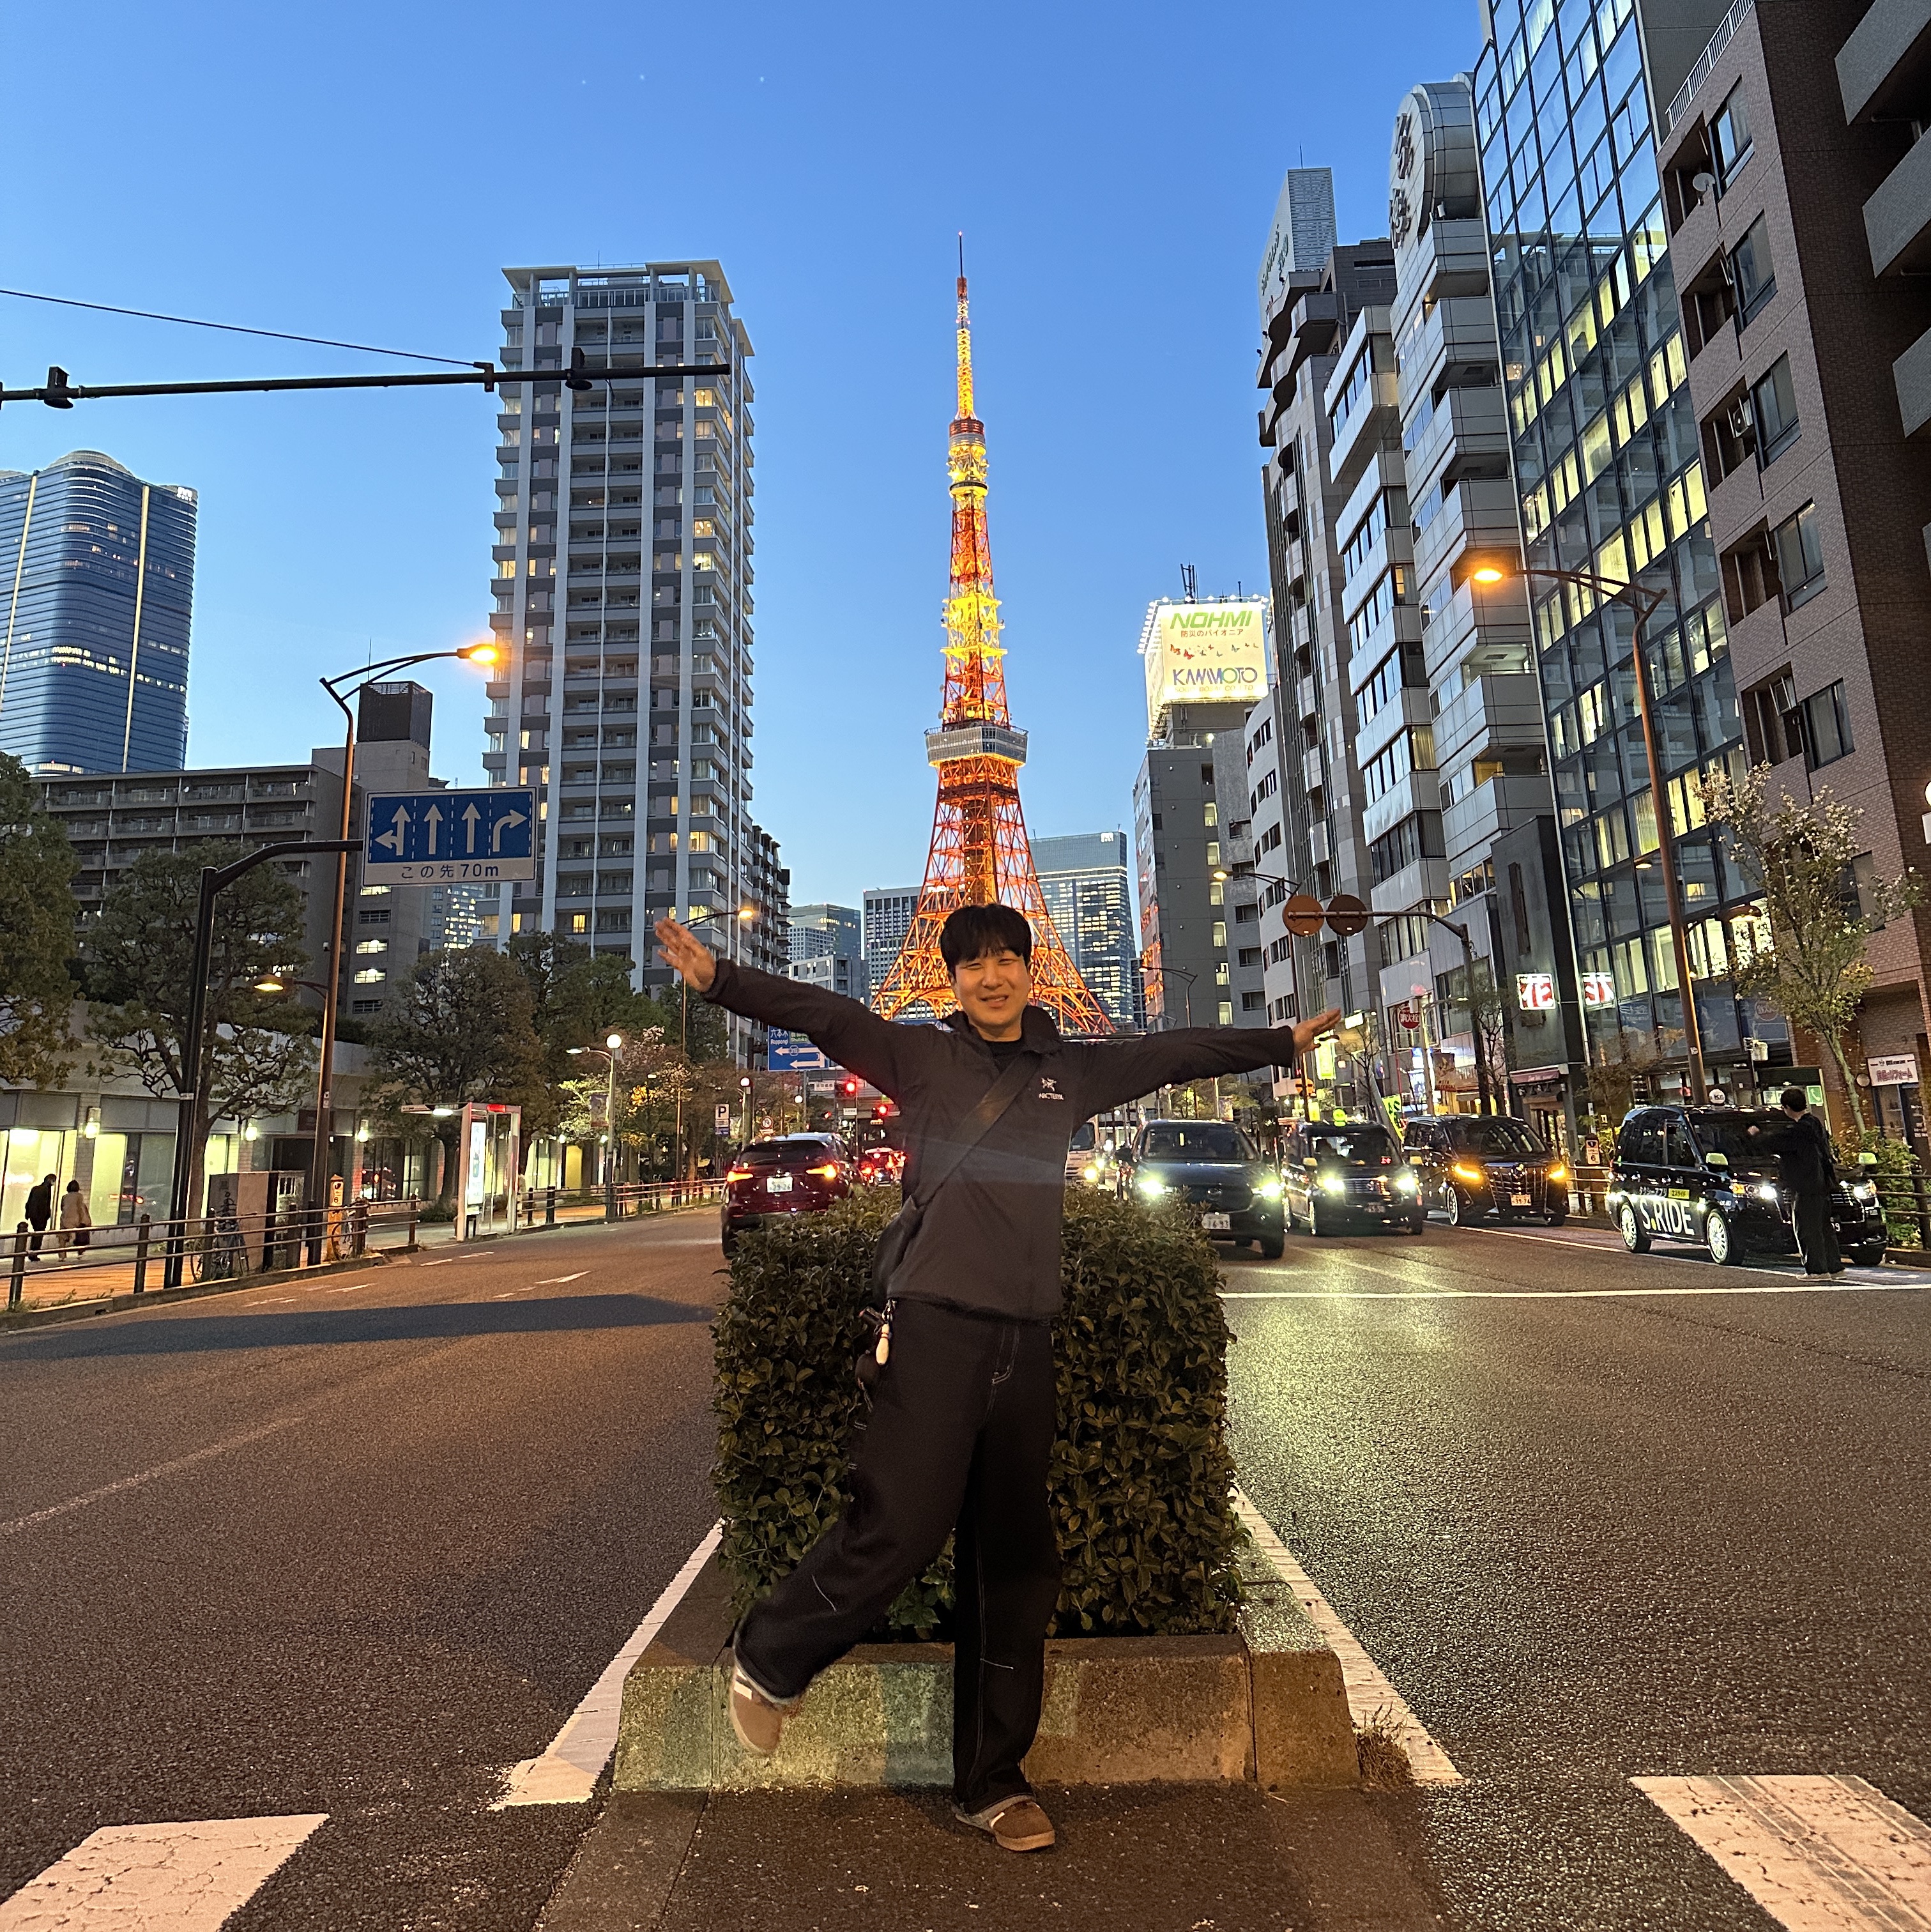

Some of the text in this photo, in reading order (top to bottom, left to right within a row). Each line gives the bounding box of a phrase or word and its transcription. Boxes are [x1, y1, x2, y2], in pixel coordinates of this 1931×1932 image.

[1170, 610, 1253, 629] NOHMI
[1180, 629, 1244, 638] 防災のパイオニア
[401, 864, 499, 879] この先70m
[1400, 1013, 1419, 1022] 消火栓
[770, 1029, 789, 1038] 六本木
[718, 1106, 727, 1117] P
[1639, 1198, 1695, 1235] S.RIDE
